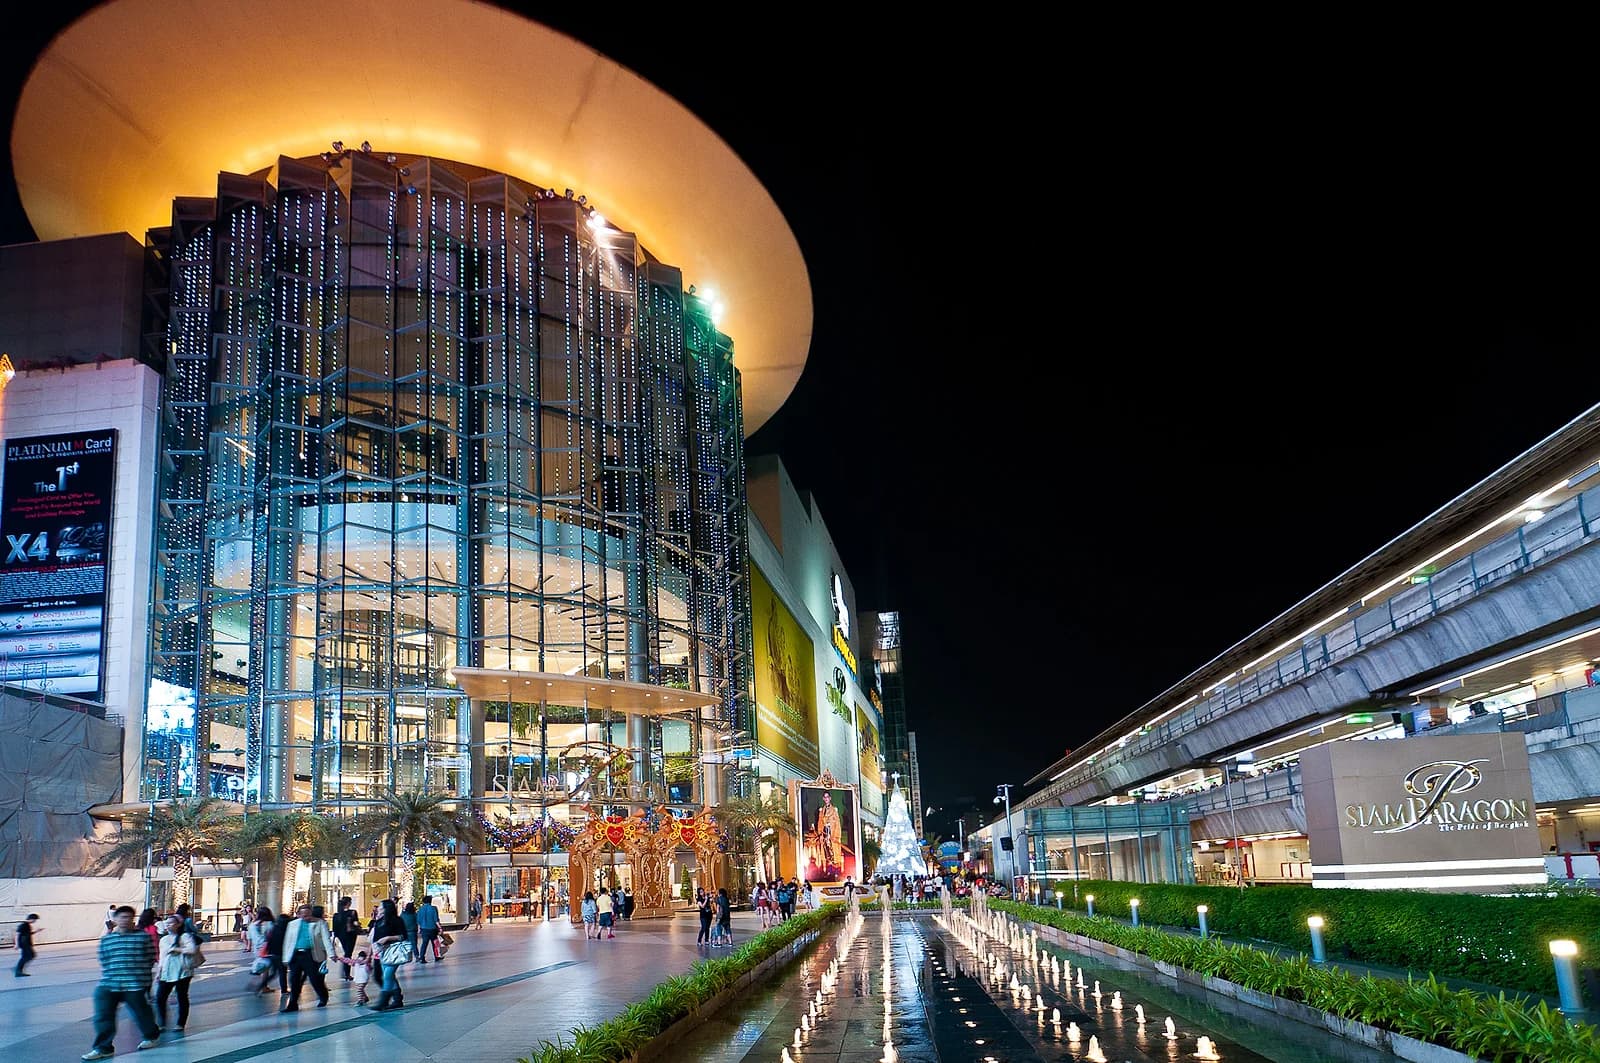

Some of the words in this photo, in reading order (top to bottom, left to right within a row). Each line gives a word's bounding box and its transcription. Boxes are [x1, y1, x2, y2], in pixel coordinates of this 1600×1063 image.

[8, 441, 71, 457] PLATINUM
[85, 436, 112, 449] Card
[34, 481, 56, 492] The
[56, 461, 80, 491] 1st
[5, 531, 50, 564] X4
[492, 774, 558, 799] SIAM
[564, 771, 671, 803] PARAGON
[1346, 803, 1405, 828] SIAM
[1406, 797, 1527, 825] PARAGON
[1439, 823, 1454, 832] The
[1457, 823, 1479, 831] Pride
[1482, 821, 1492, 831] of
